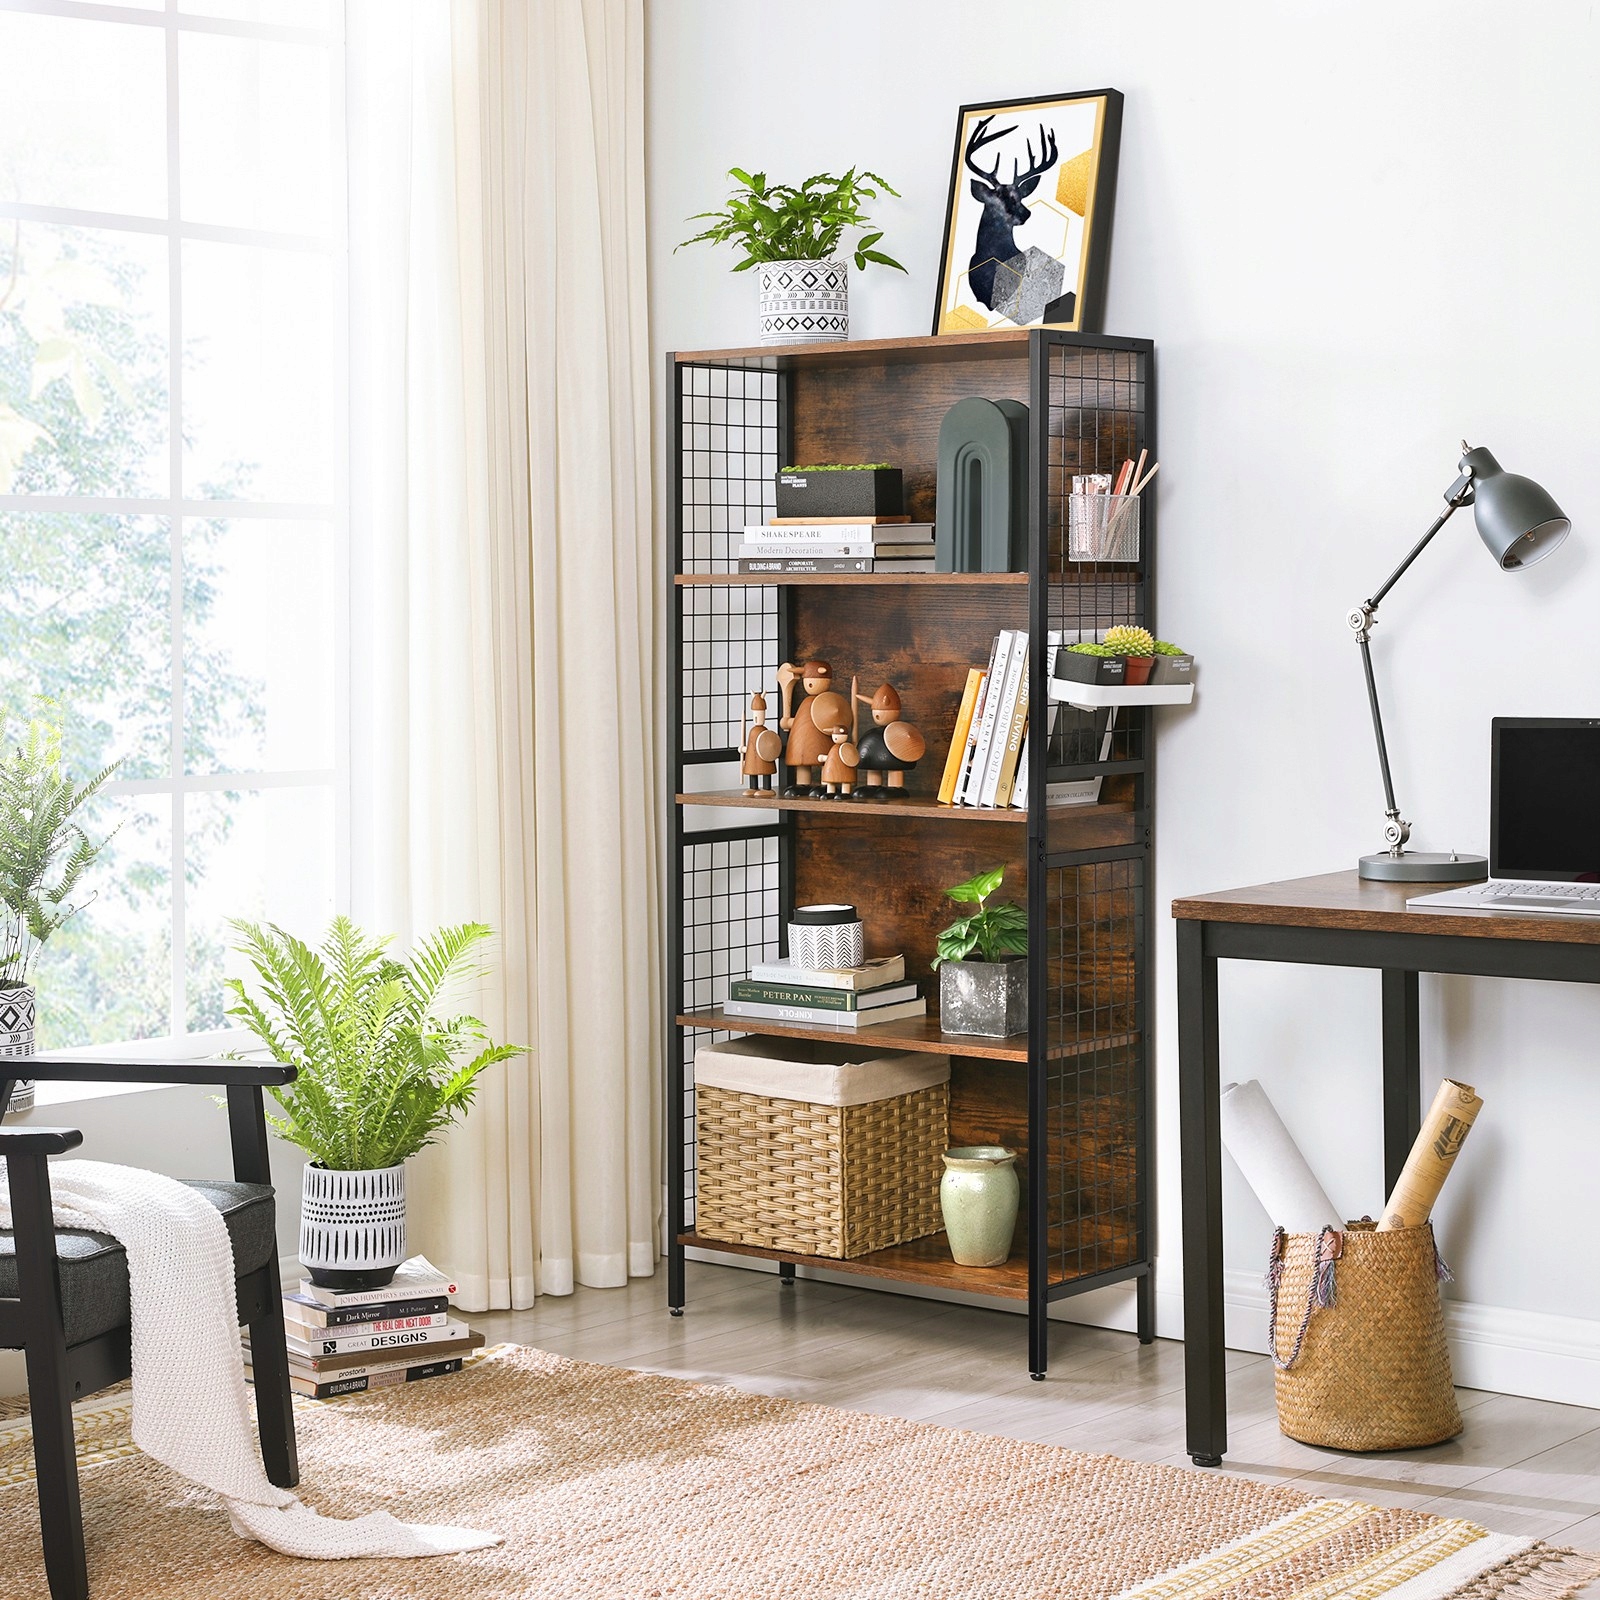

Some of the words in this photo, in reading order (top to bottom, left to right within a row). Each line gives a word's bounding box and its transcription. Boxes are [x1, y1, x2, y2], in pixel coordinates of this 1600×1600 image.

[756, 546, 784, 554] Modern
[785, 546, 824, 554] Decoration
[1008, 714, 1024, 752] LIVING
[763, 990, 791, 1001] PETER
[793, 994, 812, 1002] PAN
[778, 1008, 812, 1019] KINFOLK
[340, 1296, 358, 1304] JOHN
[360, 1292, 398, 1302] HUMPHRYS
[346, 1312, 360, 1322] Dark
[362, 1311, 380, 1320] Mirror
[373, 1322, 382, 1332] THE
[382, 1320, 393, 1330] REAL
[395, 1319, 404, 1329] GIRL
[406, 1318, 418, 1328] NEXT
[419, 1316, 431, 1326] DOOR
[371, 1332, 427, 1347] DESIGNS
[338, 1368, 366, 1378] prostoria
[374, 1372, 400, 1380] CORPORATE
